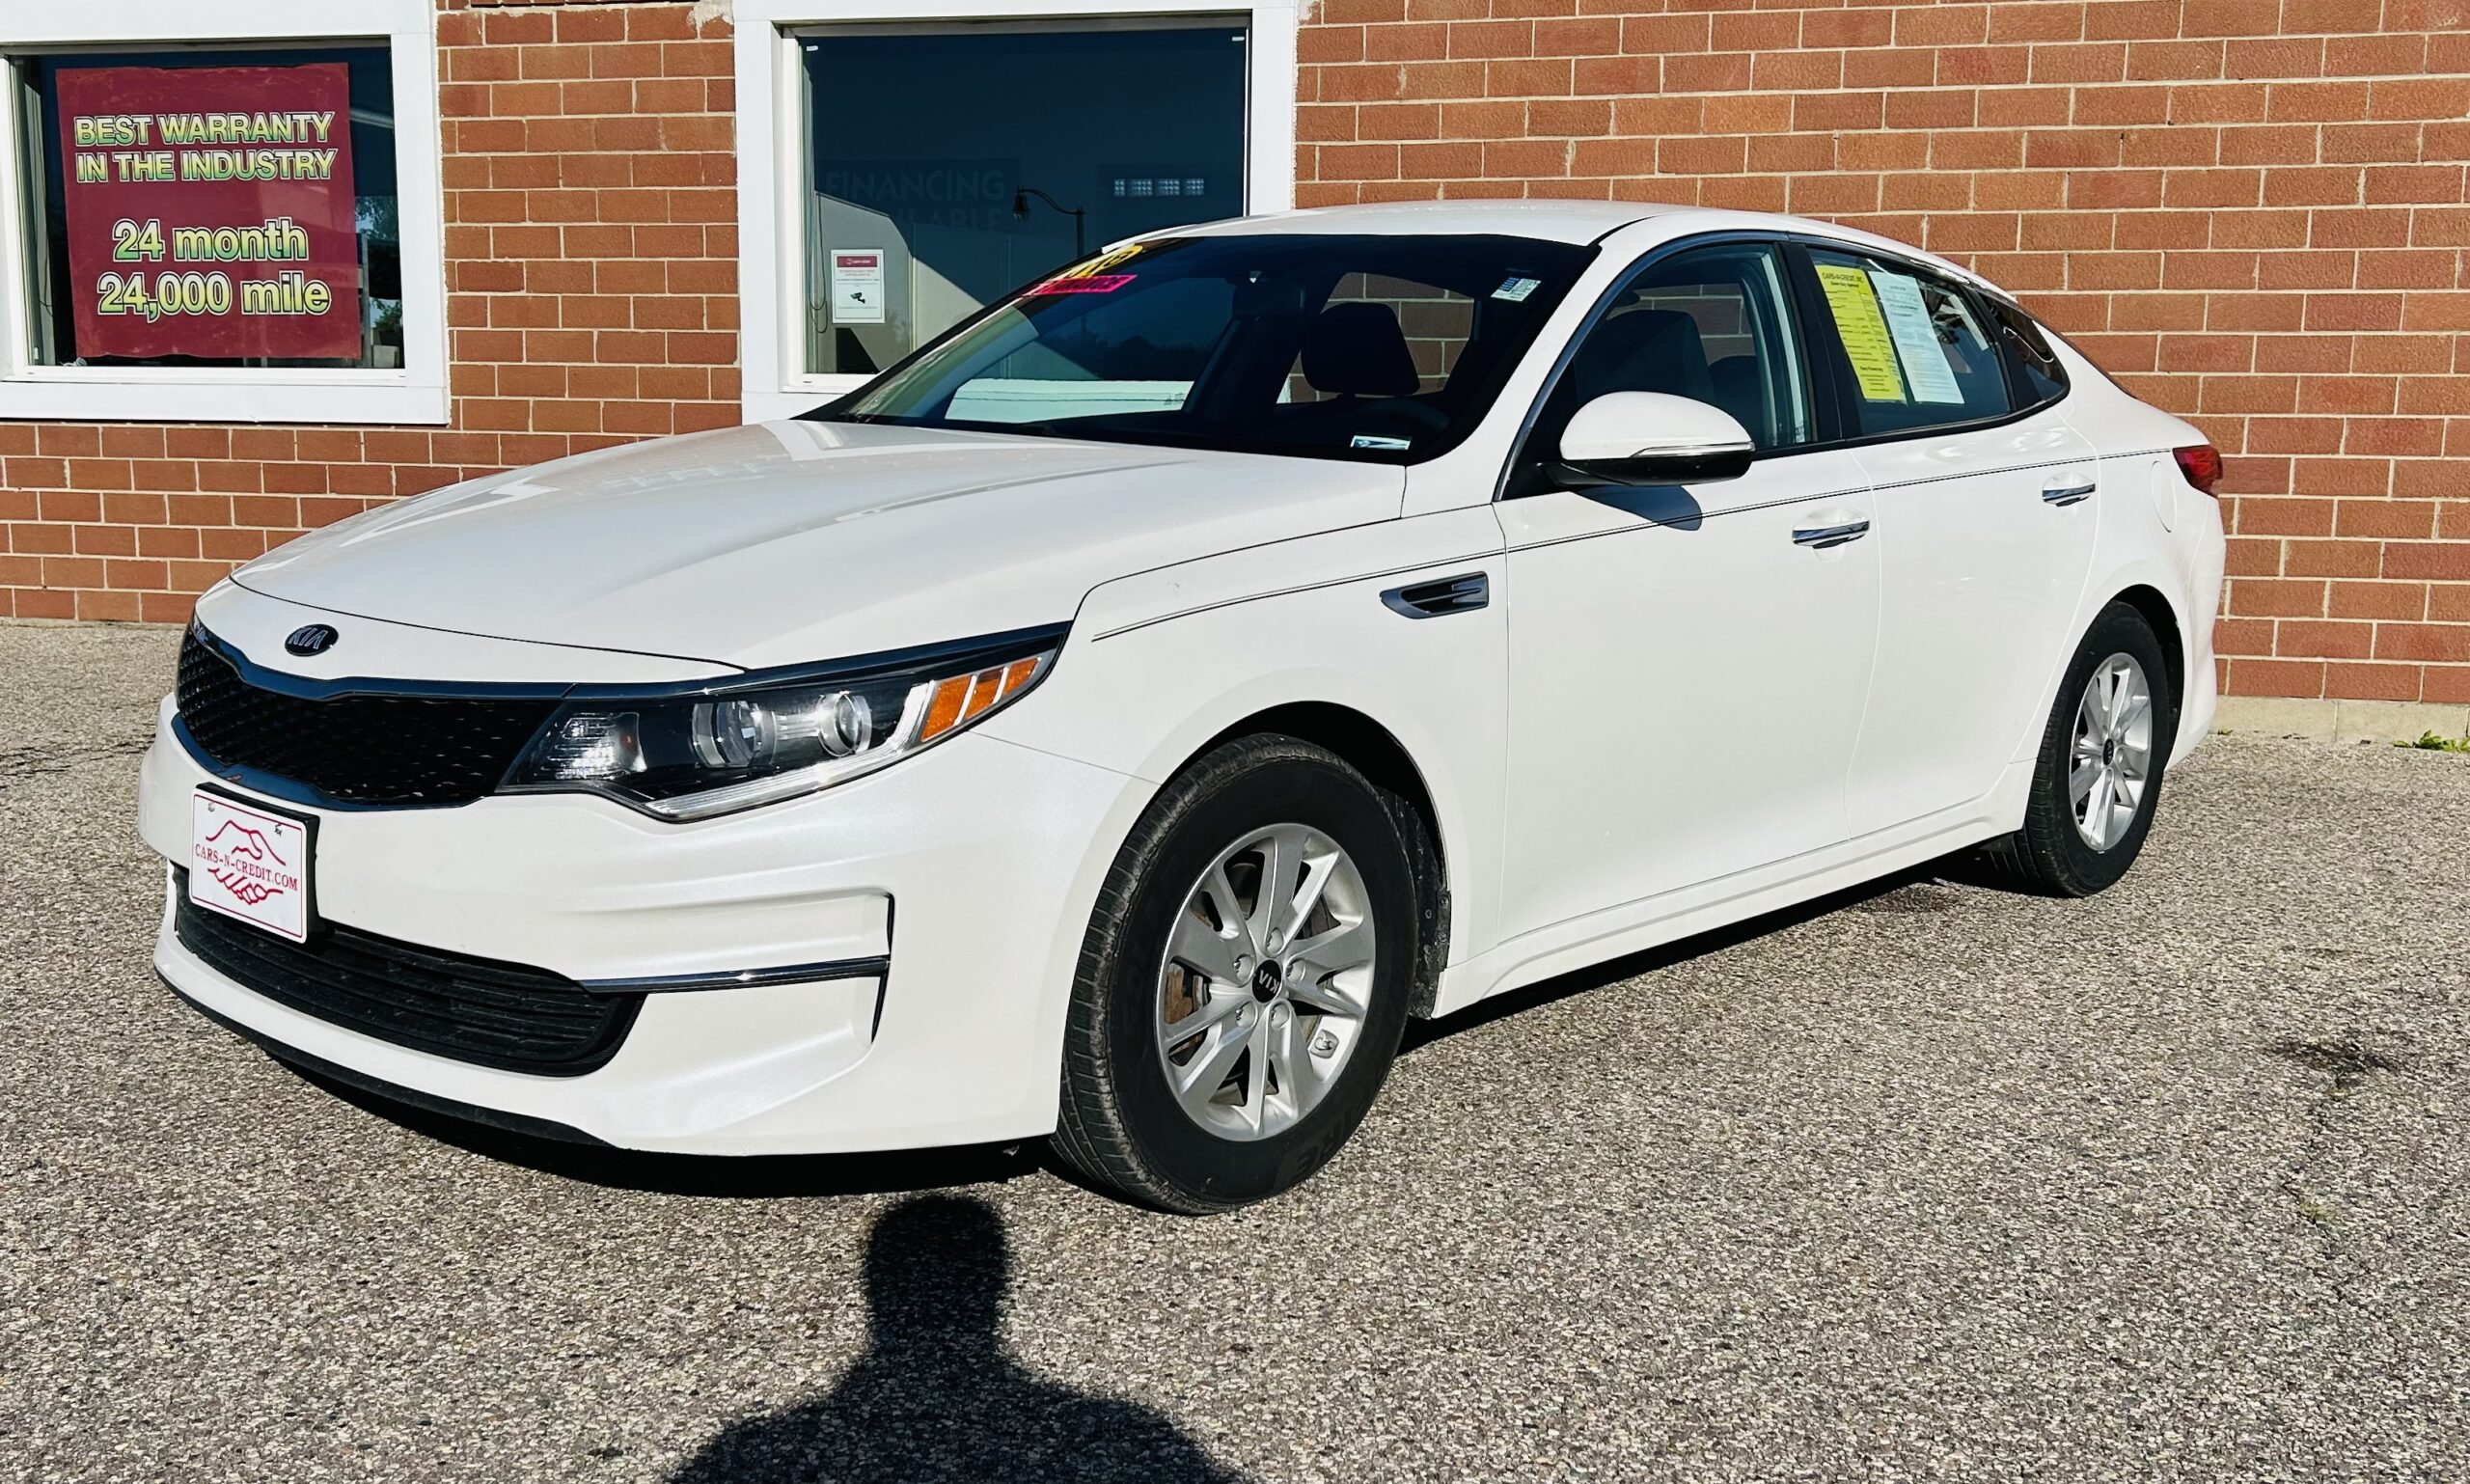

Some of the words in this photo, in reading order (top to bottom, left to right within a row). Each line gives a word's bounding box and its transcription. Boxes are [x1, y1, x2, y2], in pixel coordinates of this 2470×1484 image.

[74, 115, 151, 147] BEST
[156, 111, 336, 145] WARRANTY
[76, 152, 108, 182] IN
[112, 151, 176, 181] THE
[181, 149, 338, 180] INDUSTRY
[113, 219, 165, 261] 24
[172, 217, 309, 261] month
[97, 271, 232, 323] 24,000
[241, 270, 332, 316] mile
[288, 627, 329, 650] KIA
[195, 843, 298, 892] CARS-N-CREDIT.COM
[1259, 970, 1280, 994] KIA
